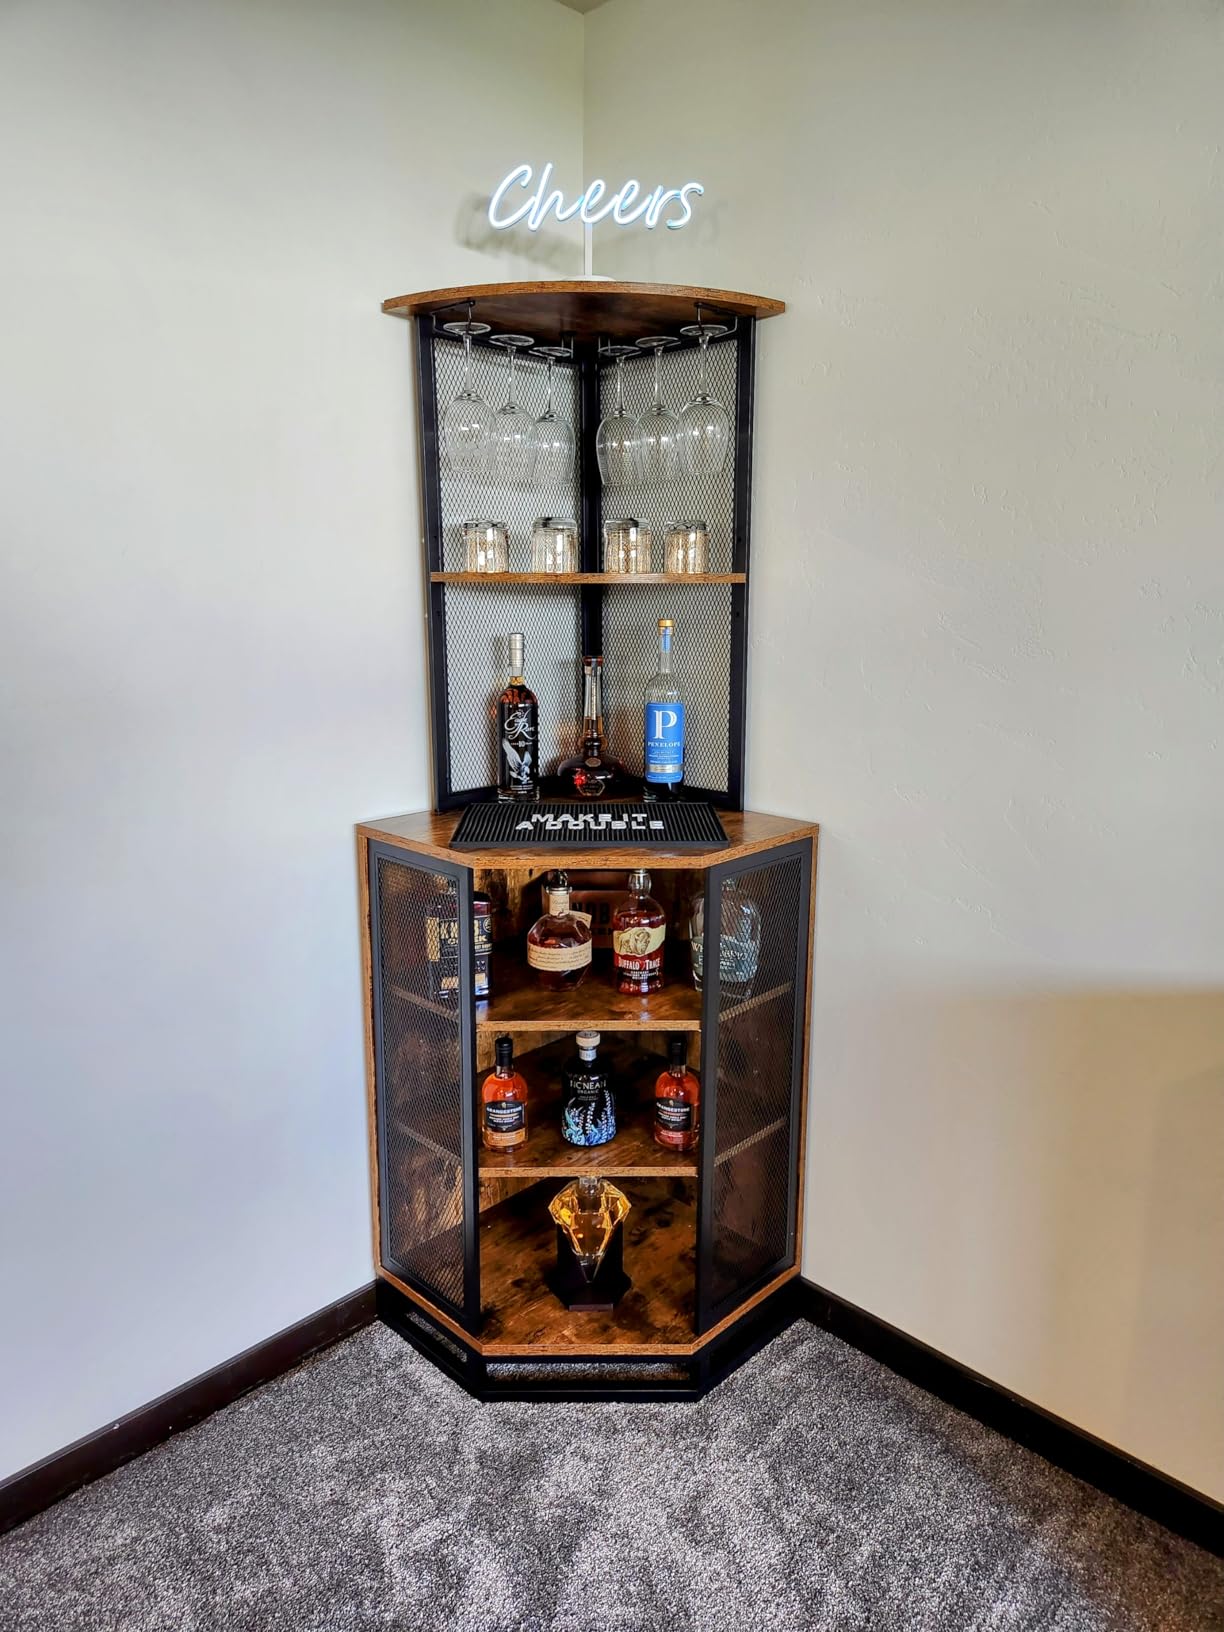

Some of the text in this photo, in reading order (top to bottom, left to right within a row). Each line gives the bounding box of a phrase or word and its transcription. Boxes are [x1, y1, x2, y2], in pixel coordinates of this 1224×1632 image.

[487, 162, 704, 231] Cheers
[652, 709, 678, 739] P
[515, 820, 664, 831] A DOUBLE
[531, 813, 648, 823] MAKE IT
[618, 956, 640, 971] BUFFALO
